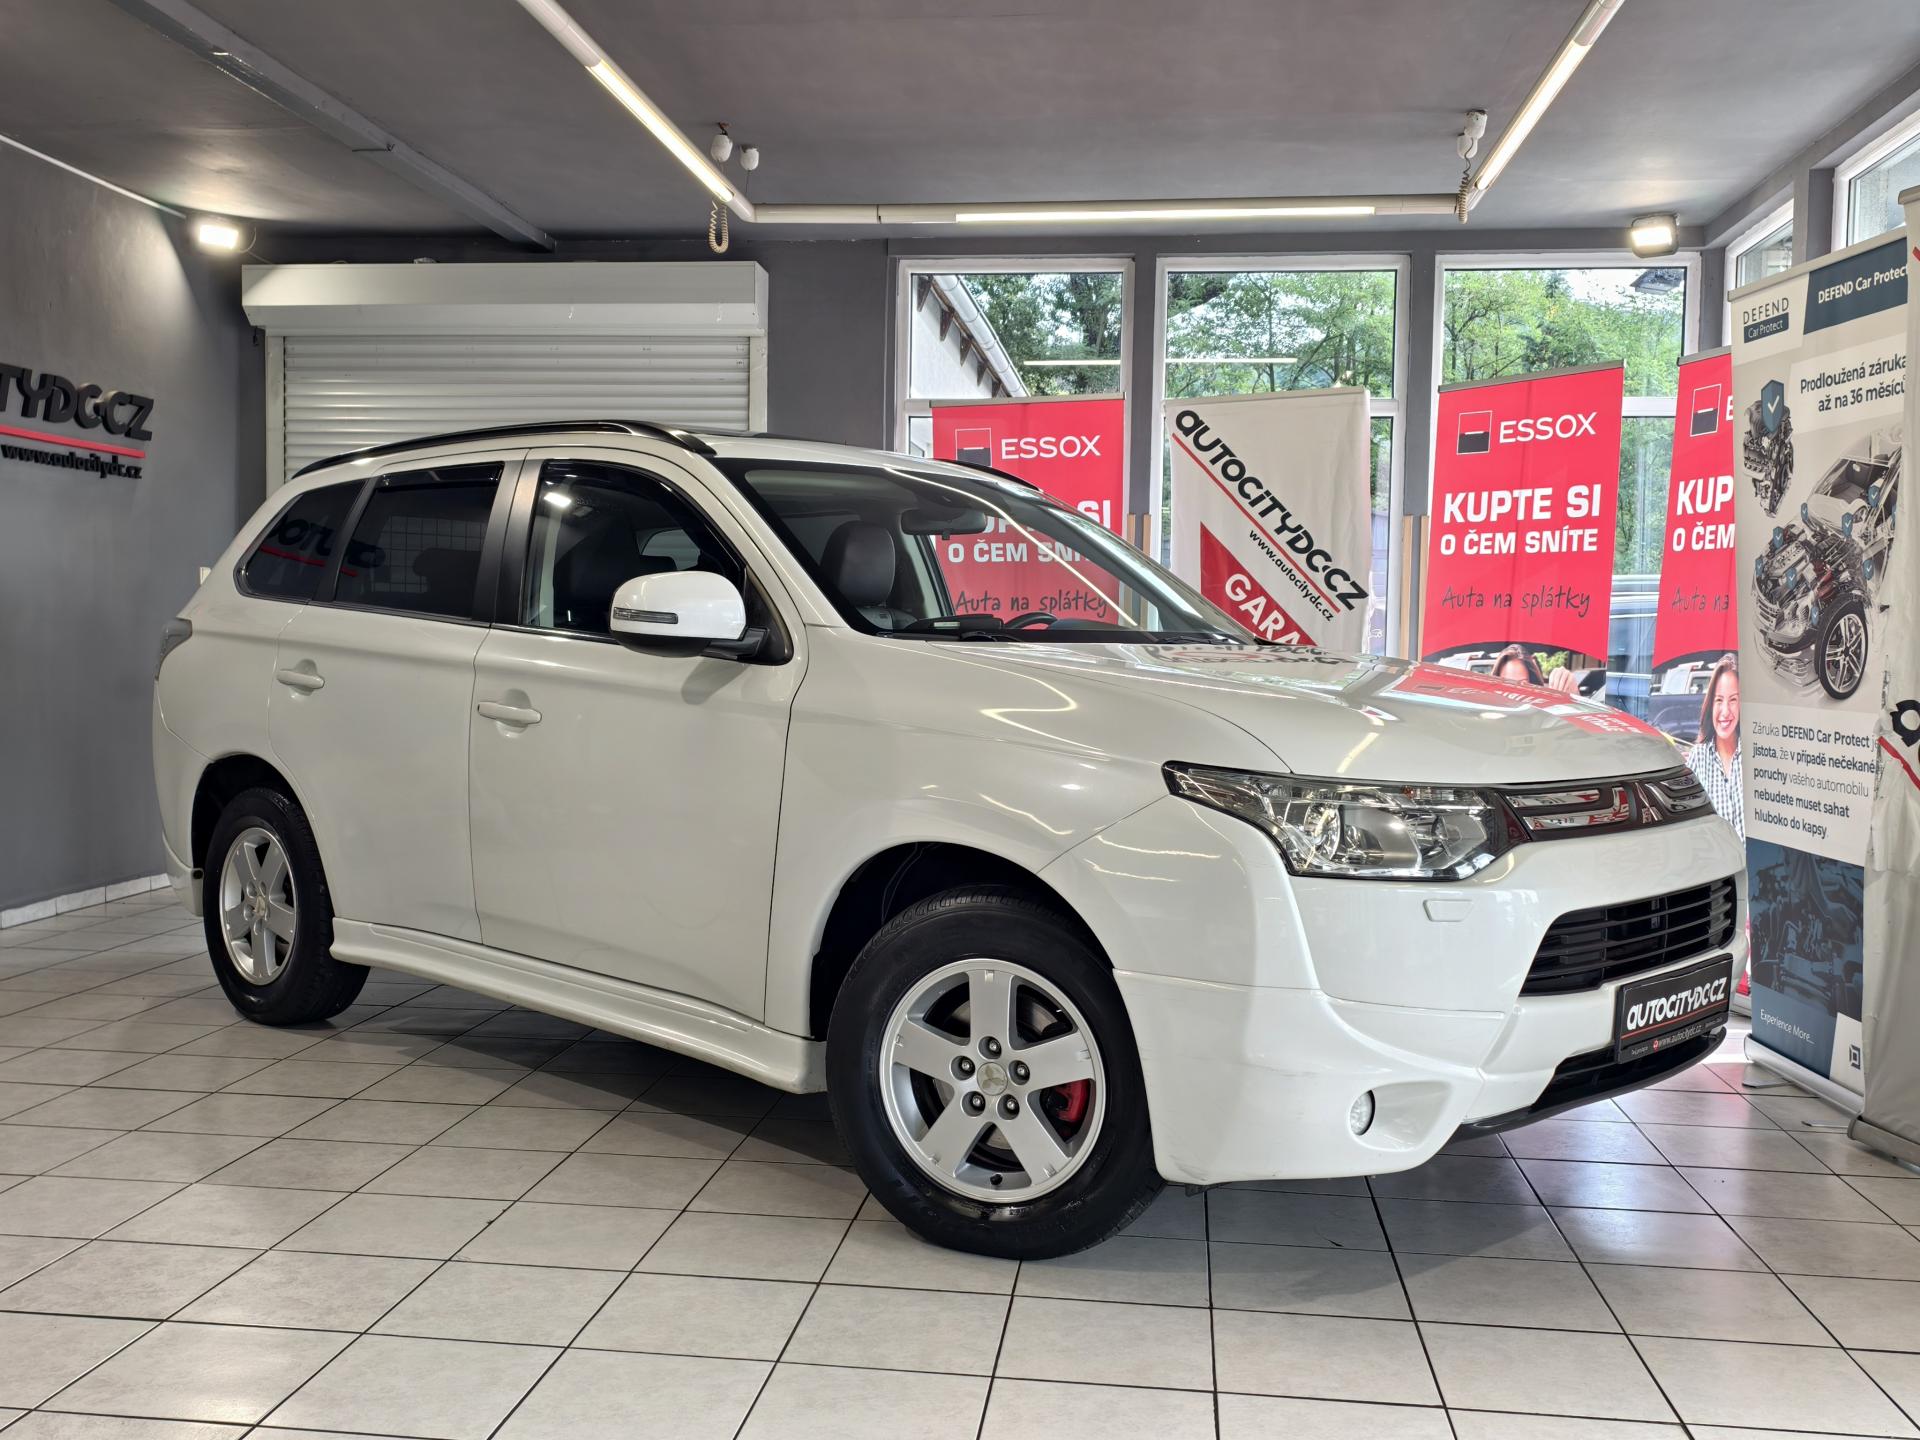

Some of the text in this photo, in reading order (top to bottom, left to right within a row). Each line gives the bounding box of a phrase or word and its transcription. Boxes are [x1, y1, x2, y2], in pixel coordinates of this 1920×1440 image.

[1818, 283, 1853, 304] DEFEND
[1856, 277, 1871, 291] Car
[1743, 297, 1790, 325] DEFEND
[1748, 319, 1783, 339] Car Protect
[1801, 361, 1866, 394] Prodloužená
[1818, 395, 1832, 412] až
[1835, 394, 1848, 408] na
[1850, 388, 1863, 405] 36
[1499, 411, 1597, 444] ESSOX
[0, 444, 142, 479] www.autocitydc.cz
[1001, 434, 1101, 460] ESSOX
[1077, 500, 1111, 529] SI
[1443, 484, 1601, 523] KUPTE SI
[1440, 525, 1598, 555] O ČEM SNÍTE
[1673, 521, 1736, 551] O ČEM
[948, 543, 965, 563] O
[974, 539, 1028, 563] ČEM
[1250, 530, 1334, 622] www.autocitydc.cz
[956, 589, 1107, 618] Auta na splátky
[1442, 586, 1592, 617] Auta na splátky
[1672, 590, 1729, 610] Auta na
[1752, 721, 1780, 737] Záruka
[1781, 725, 1815, 741] DEFEND
[1816, 729, 1831, 743] Car
[1834, 732, 1870, 748] Protect
[1752, 742, 1778, 759] jistota,
[1779, 747, 1789, 760] že
[1796, 751, 1826, 766] případě
[1828, 756, 1875, 774] nečekané
[1753, 767, 1869, 798] poruchy vašeho automobilu
[1754, 788, 1850, 818] nebudete muset sahat
[1754, 808, 1789, 827] hluboko
[1790, 816, 1801, 830] do
[1760, 1008, 1792, 1033] Experience
